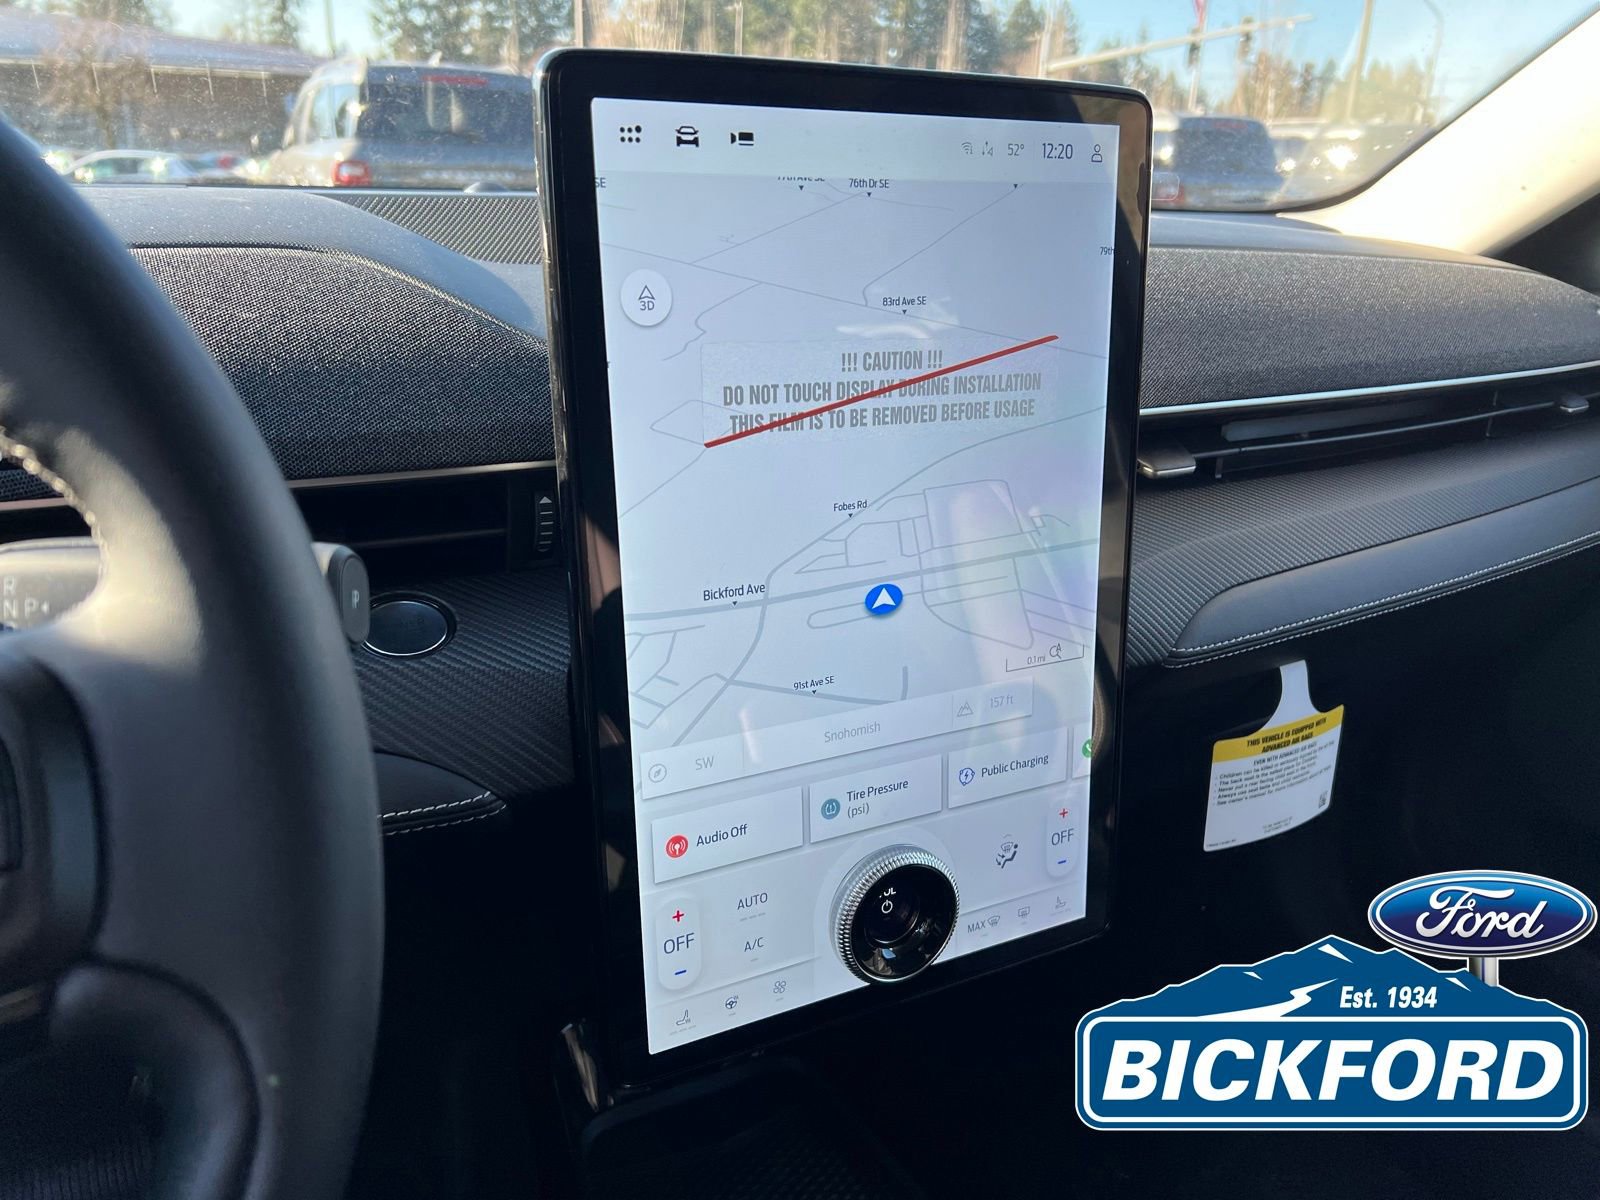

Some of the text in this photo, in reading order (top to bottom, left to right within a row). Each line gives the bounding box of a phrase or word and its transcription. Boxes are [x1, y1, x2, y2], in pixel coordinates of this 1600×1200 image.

[1007, 143, 1025, 156] 52°
[1042, 143, 1073, 159] 12:20
[848, 178, 890, 188] 76th Dr SE
[639, 300, 655, 311] 3D
[882, 296, 926, 306] 83rd Ave SE
[841, 350, 943, 372] !!! CAUTION !!!
[723, 372, 1042, 406] DO NOT TOUCH DISPLAY DURING INSTALLATION
[730, 399, 1035, 435] THIS FILM IS TO BE REMOVED BEFORE USAGE
[832, 499, 868, 512] Fobes Rd
[3, 576, 17, 596] R
[703, 583, 766, 602] Bickford Ave
[3, 599, 17, 618] N
[793, 675, 835, 691] 91st Ave SE
[990, 695, 1014, 708] 157 ft
[824, 721, 881, 743] Snohomish
[1261, 732, 1284, 744] VEHICLE
[695, 756, 715, 771] SW
[981, 753, 1049, 777] Public Charging
[847, 779, 909, 802] Tire Pressure
[847, 802, 870, 818] (psi)
[696, 823, 748, 847] Audio Off
[1051, 828, 1075, 846] OFF
[737, 892, 768, 910] AUTO
[967, 919, 986, 934] MAX
[663, 932, 695, 954] OFF
[743, 936, 765, 953] A/C
